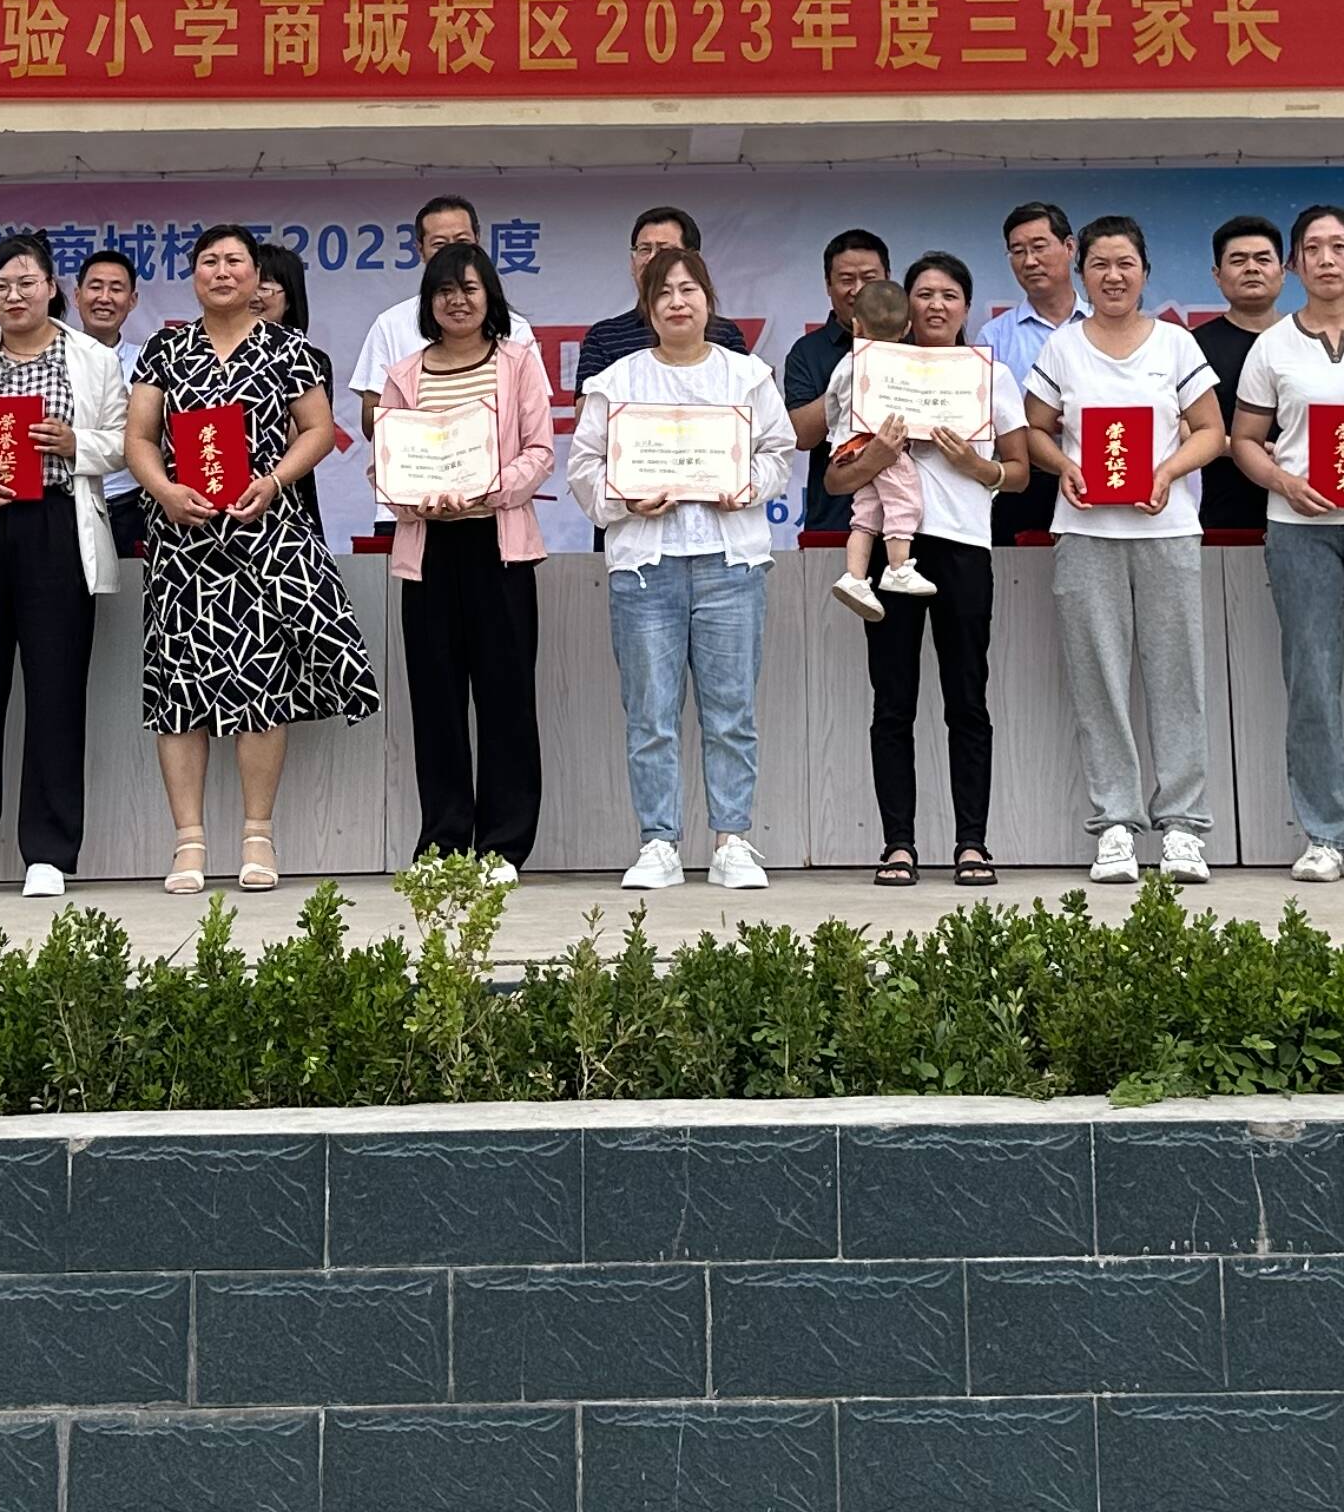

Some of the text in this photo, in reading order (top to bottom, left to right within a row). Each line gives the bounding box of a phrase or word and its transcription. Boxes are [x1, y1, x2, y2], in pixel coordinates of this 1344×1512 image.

[197, 423, 225, 496] 荣誉证书
[1103, 420, 1130, 490] 荣誉证书
